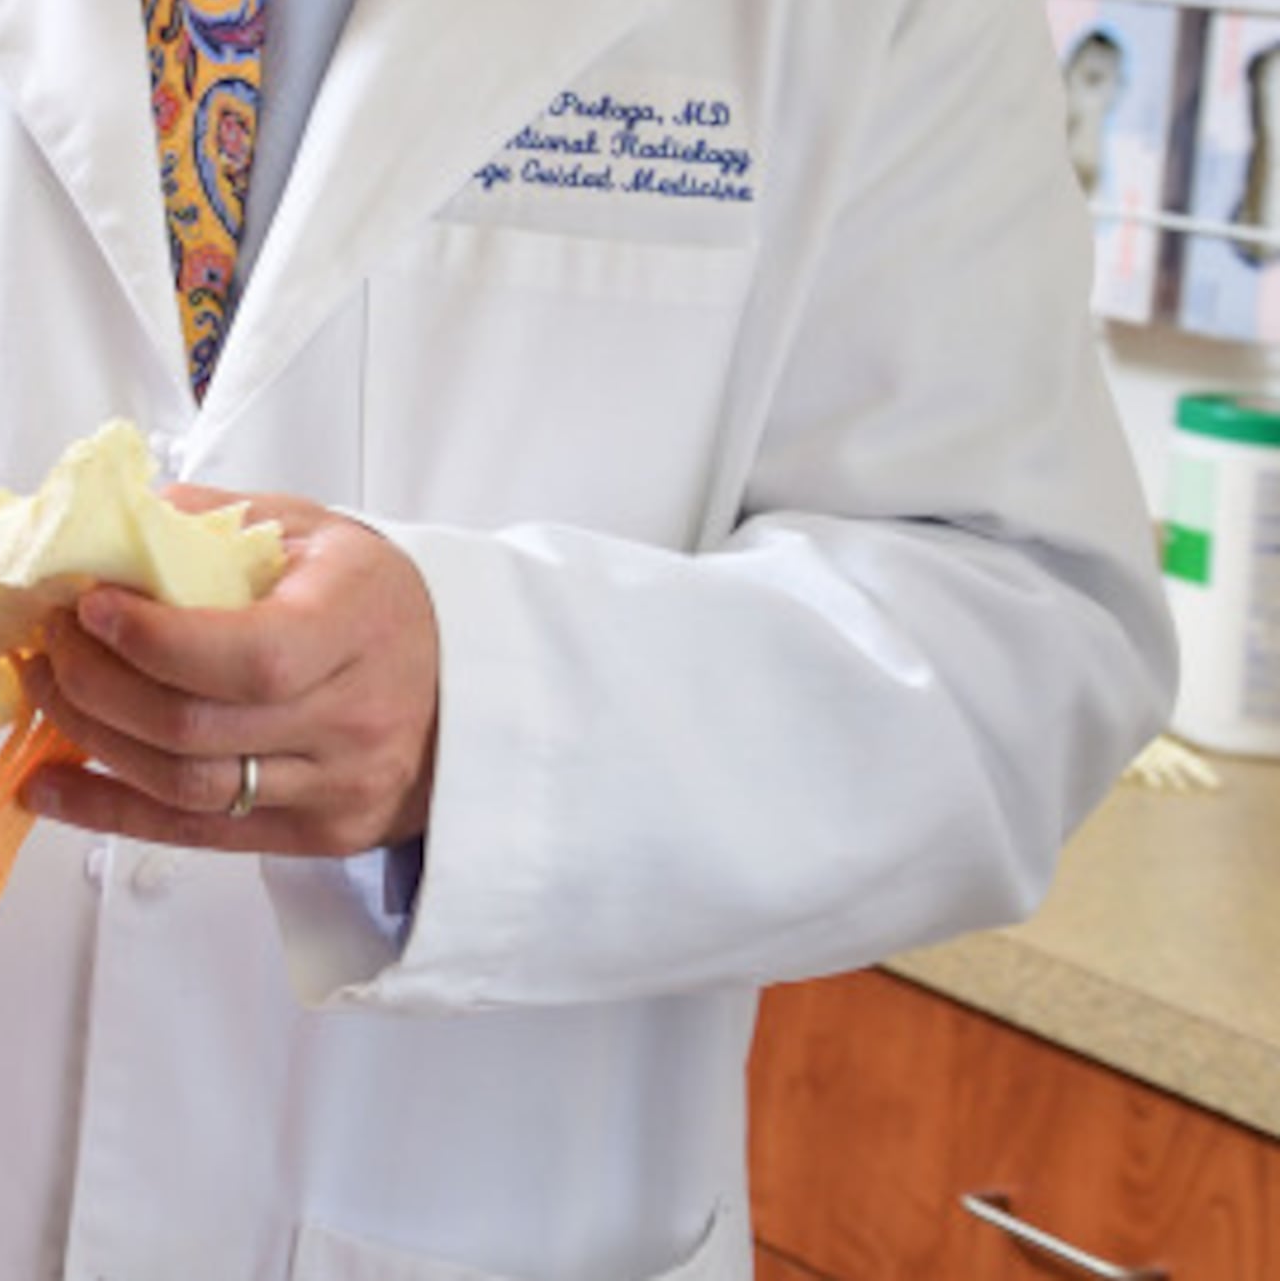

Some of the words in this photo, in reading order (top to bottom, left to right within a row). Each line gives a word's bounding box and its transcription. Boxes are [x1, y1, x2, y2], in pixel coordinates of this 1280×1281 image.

[672, 101, 731, 126] MD
[610, 129, 752, 175] Radiology
[622, 168, 755, 202] Medicine
